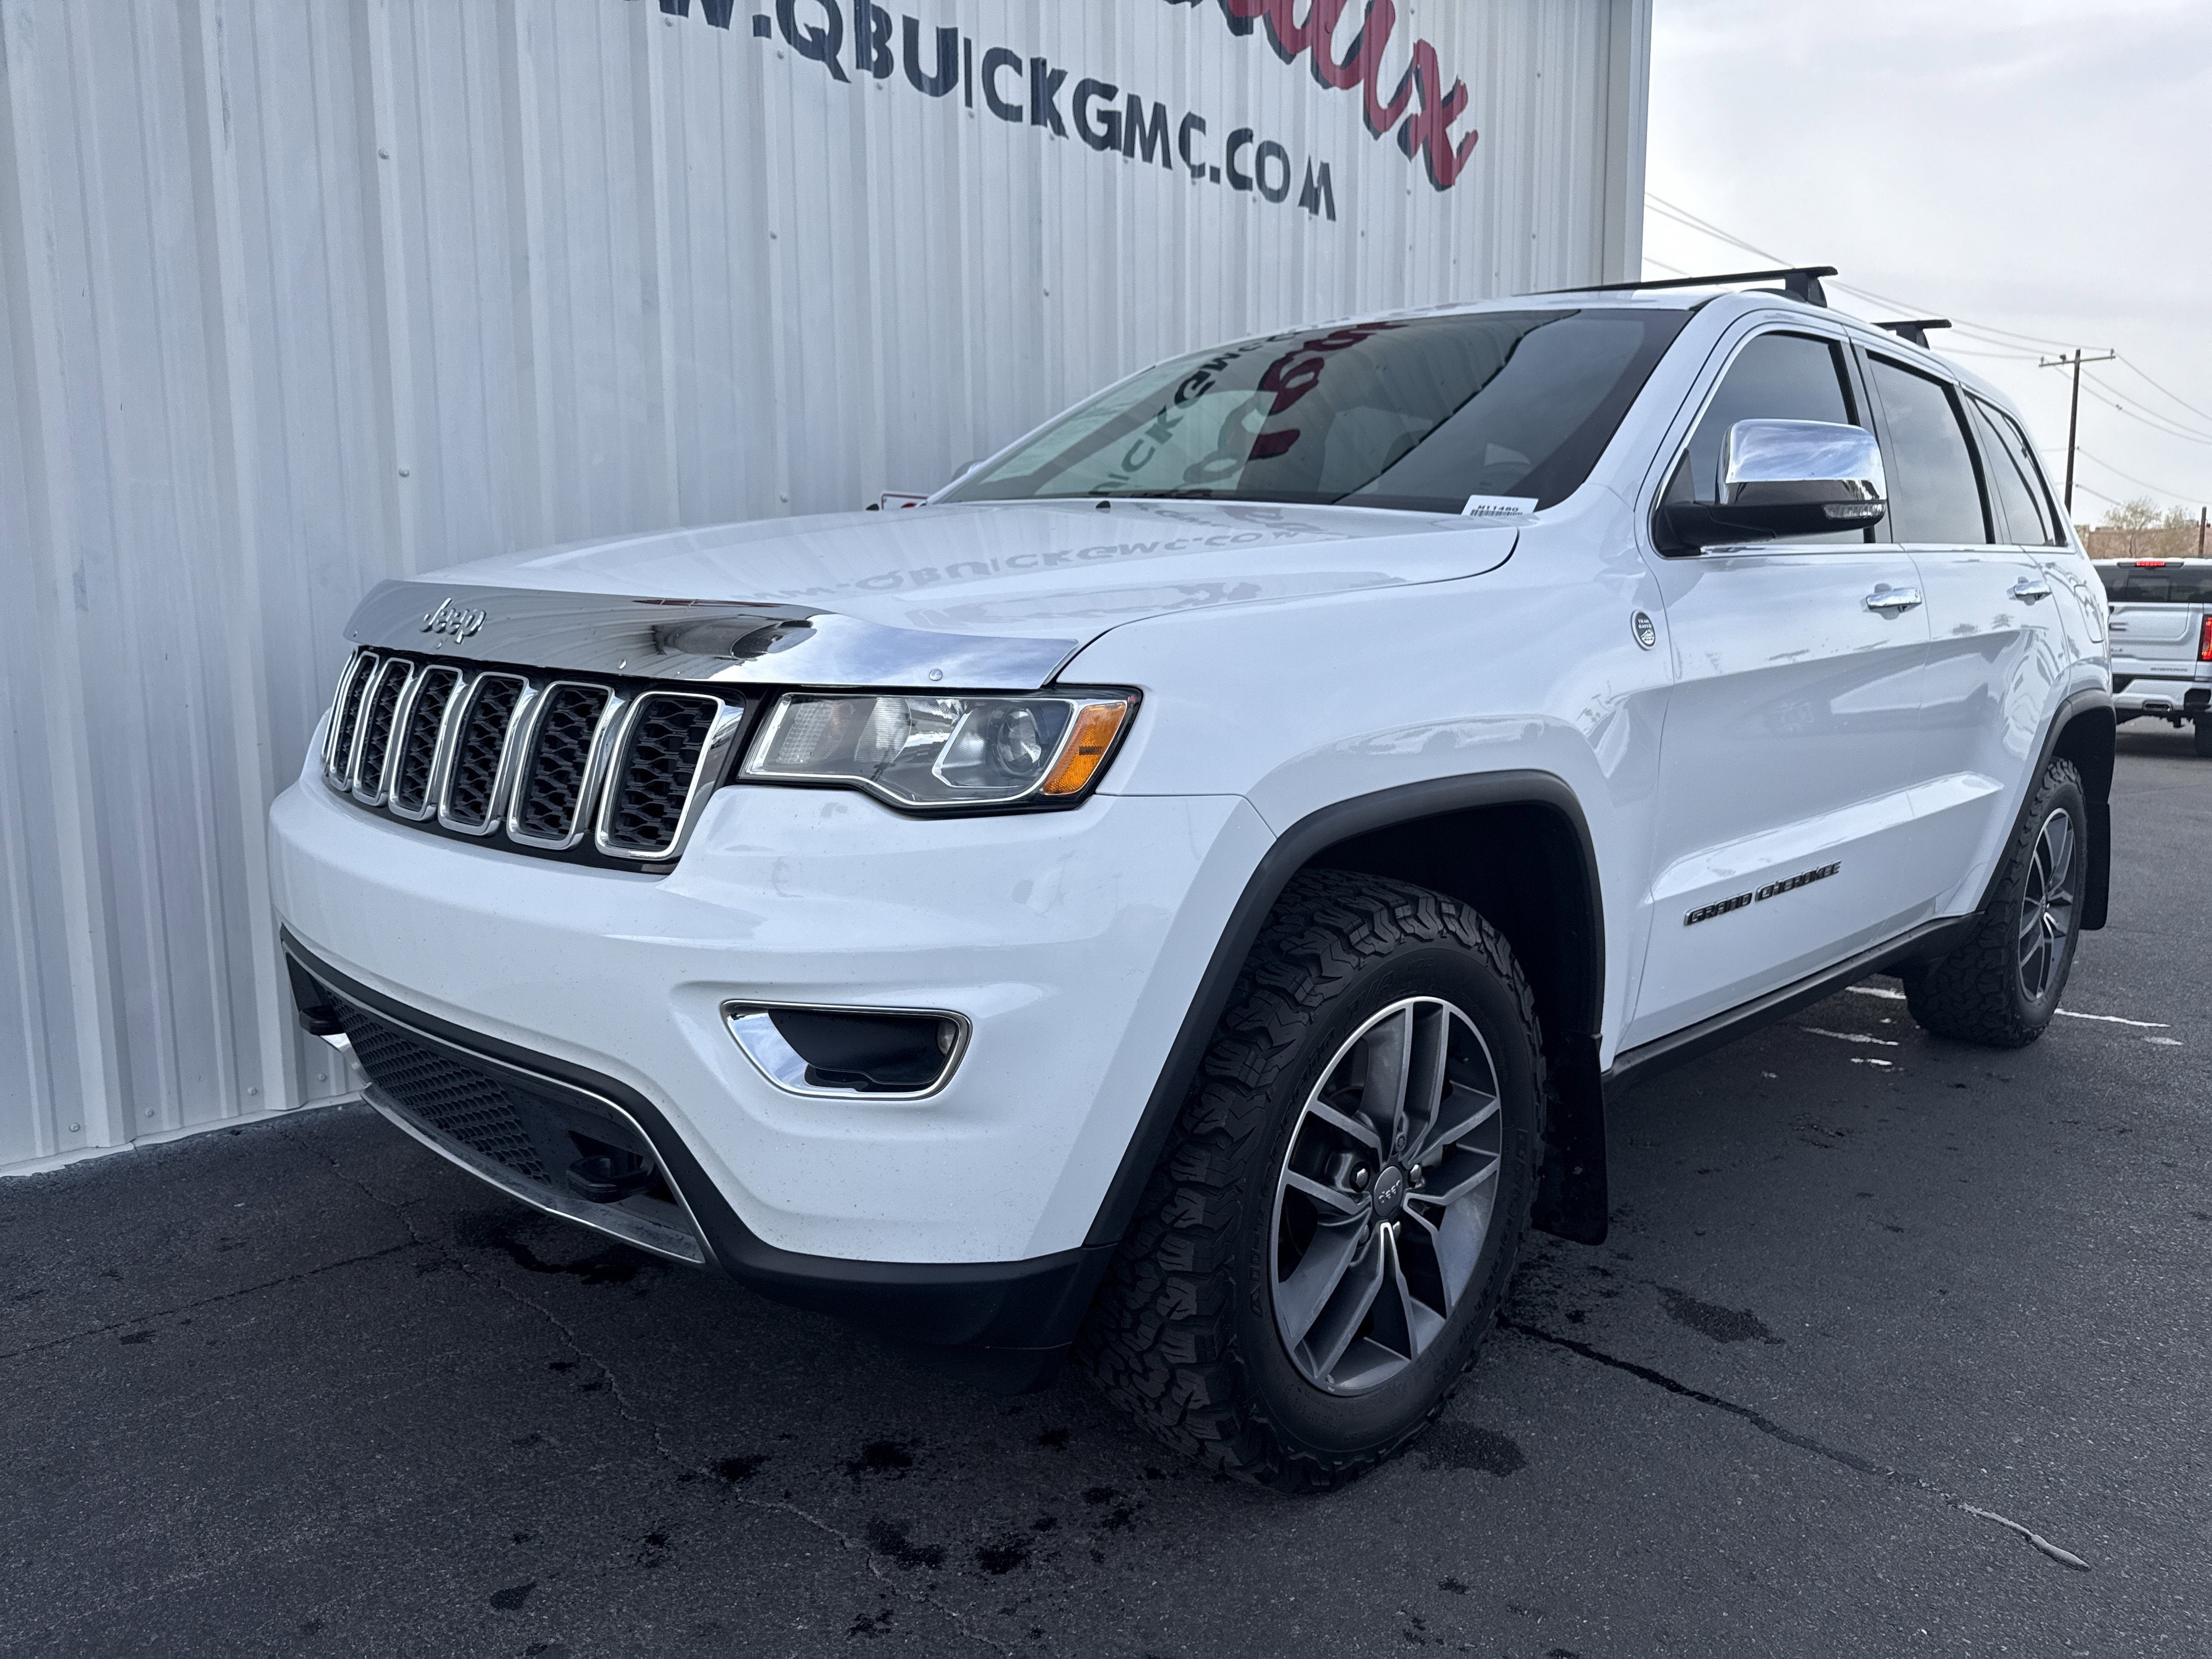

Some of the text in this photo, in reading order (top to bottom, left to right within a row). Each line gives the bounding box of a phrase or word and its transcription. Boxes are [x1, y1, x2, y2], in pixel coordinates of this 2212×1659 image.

[659, 0, 1336, 221] .QBUICKGMC.COM
[419, 597, 487, 644] Jeep
[1684, 860, 1843, 926] GRAND CHEROKEE
